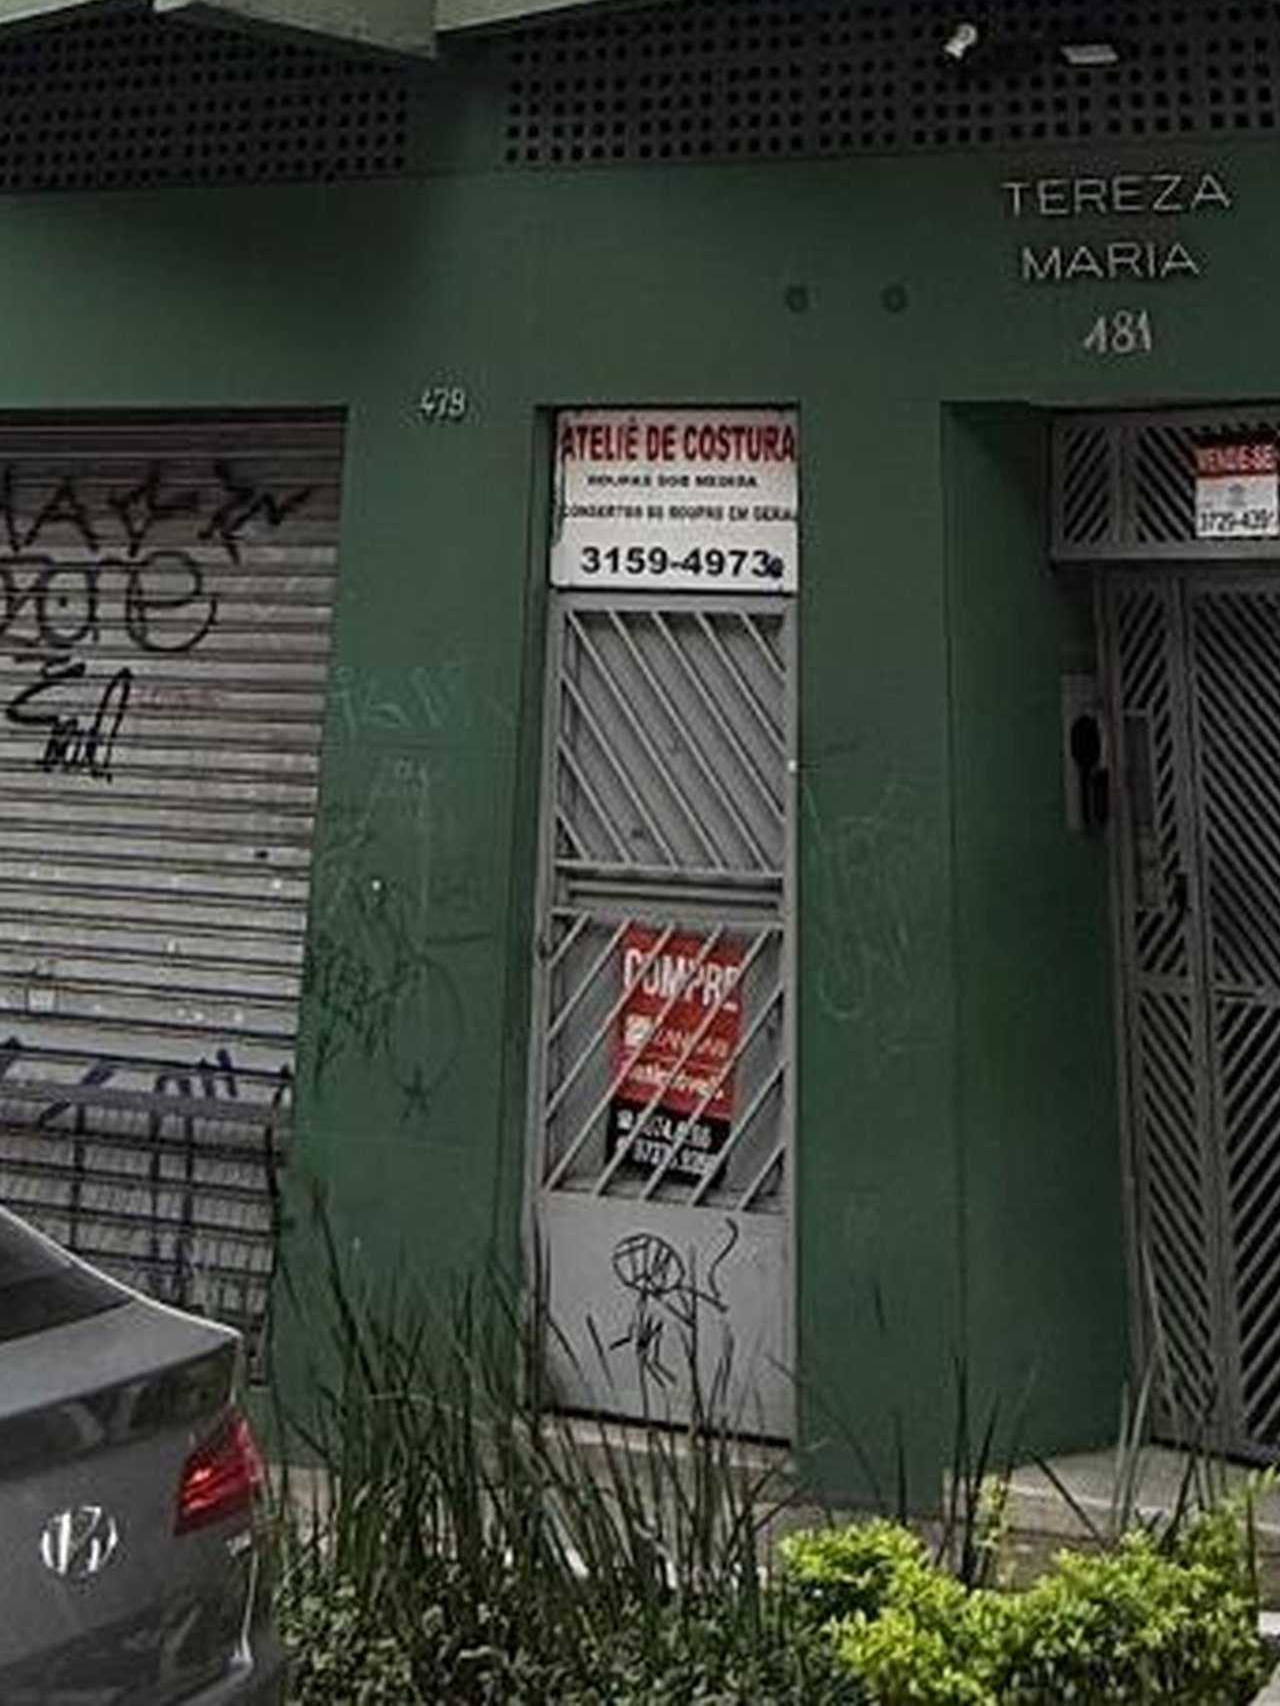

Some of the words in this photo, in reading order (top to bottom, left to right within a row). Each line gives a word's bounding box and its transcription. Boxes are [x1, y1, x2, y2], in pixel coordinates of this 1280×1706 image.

[1000, 173, 1232, 217] TEREZA
[1022, 242, 1200, 279] MARIA
[1083, 309, 1152, 354] 181
[420, 388, 465, 417] 479
[646, 426, 676, 461] DE
[683, 424, 796, 463] COSTURA
